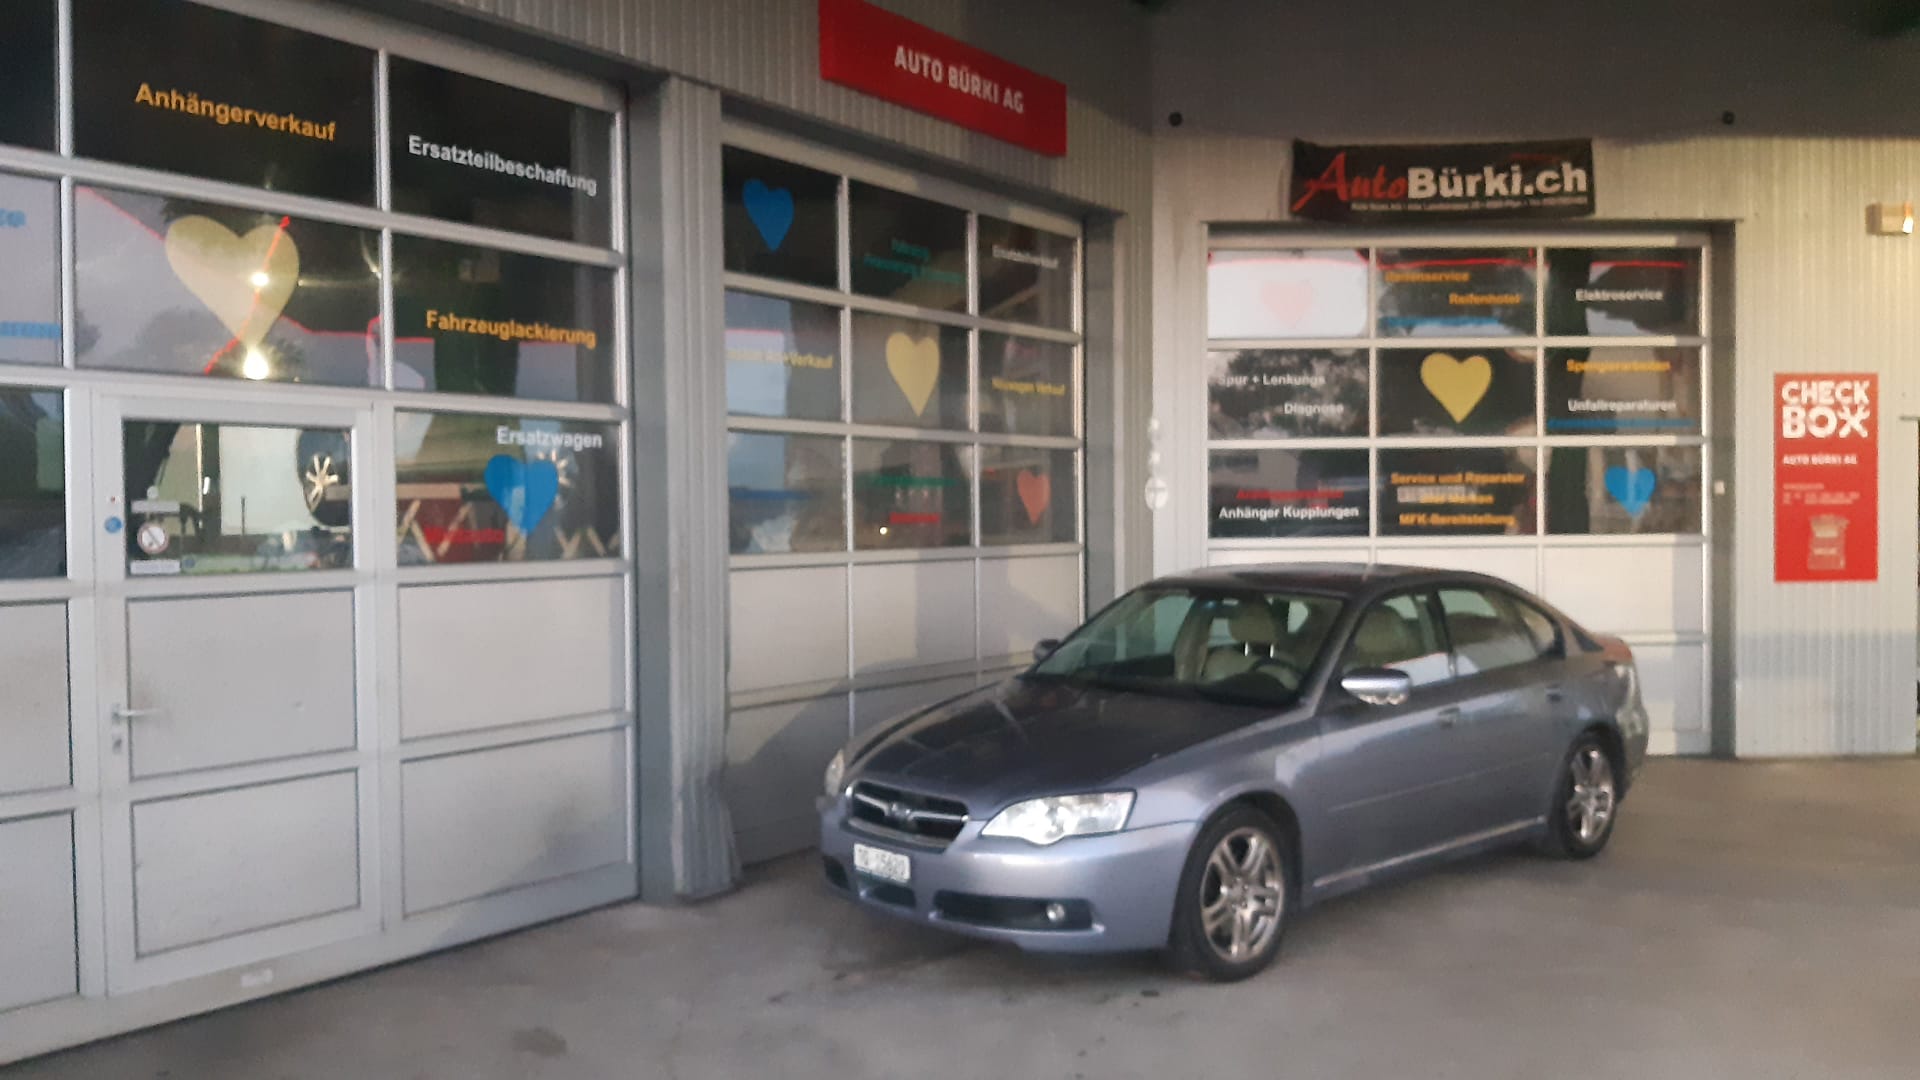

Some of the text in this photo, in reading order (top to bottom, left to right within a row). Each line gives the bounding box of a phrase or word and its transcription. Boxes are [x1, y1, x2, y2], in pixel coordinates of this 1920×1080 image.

[894, 45, 1024, 114] AUTO BÜRKI AG
[135, 82, 336, 142] Anhängerverkauf
[408, 134, 598, 197] Ersatzteilbeschaffung
[1575, 288, 1664, 301] Elektroservice
[426, 310, 597, 349] Fahrzeuglackierung
[1781, 380, 1871, 405] CHECK
[497, 426, 603, 452] Ersatzwagen
[1782, 404, 1871, 439] BOX
[1219, 506, 1360, 521] Anhänger Kupplungen
